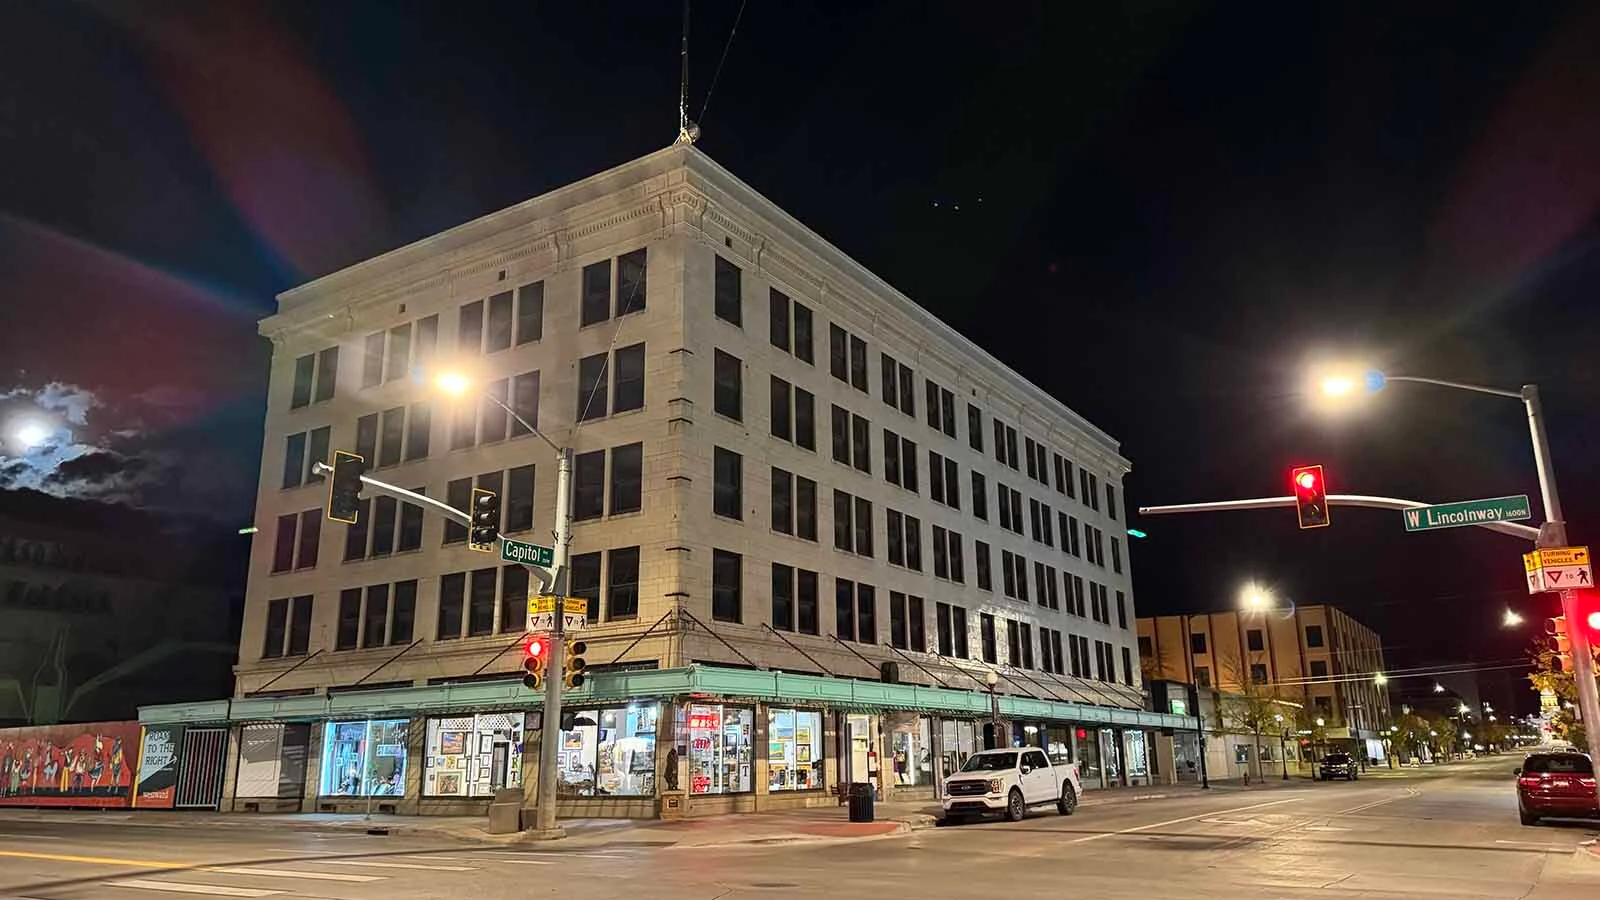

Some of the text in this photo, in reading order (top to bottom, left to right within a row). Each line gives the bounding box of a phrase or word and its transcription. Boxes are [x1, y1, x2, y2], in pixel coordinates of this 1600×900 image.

[1407, 510, 1420, 527] W
[1427, 507, 1503, 526] Lincolnway
[505, 541, 541, 561] Capitol
[147, 743, 175, 753] TO THE
[145, 756, 168, 765] RIGHT
